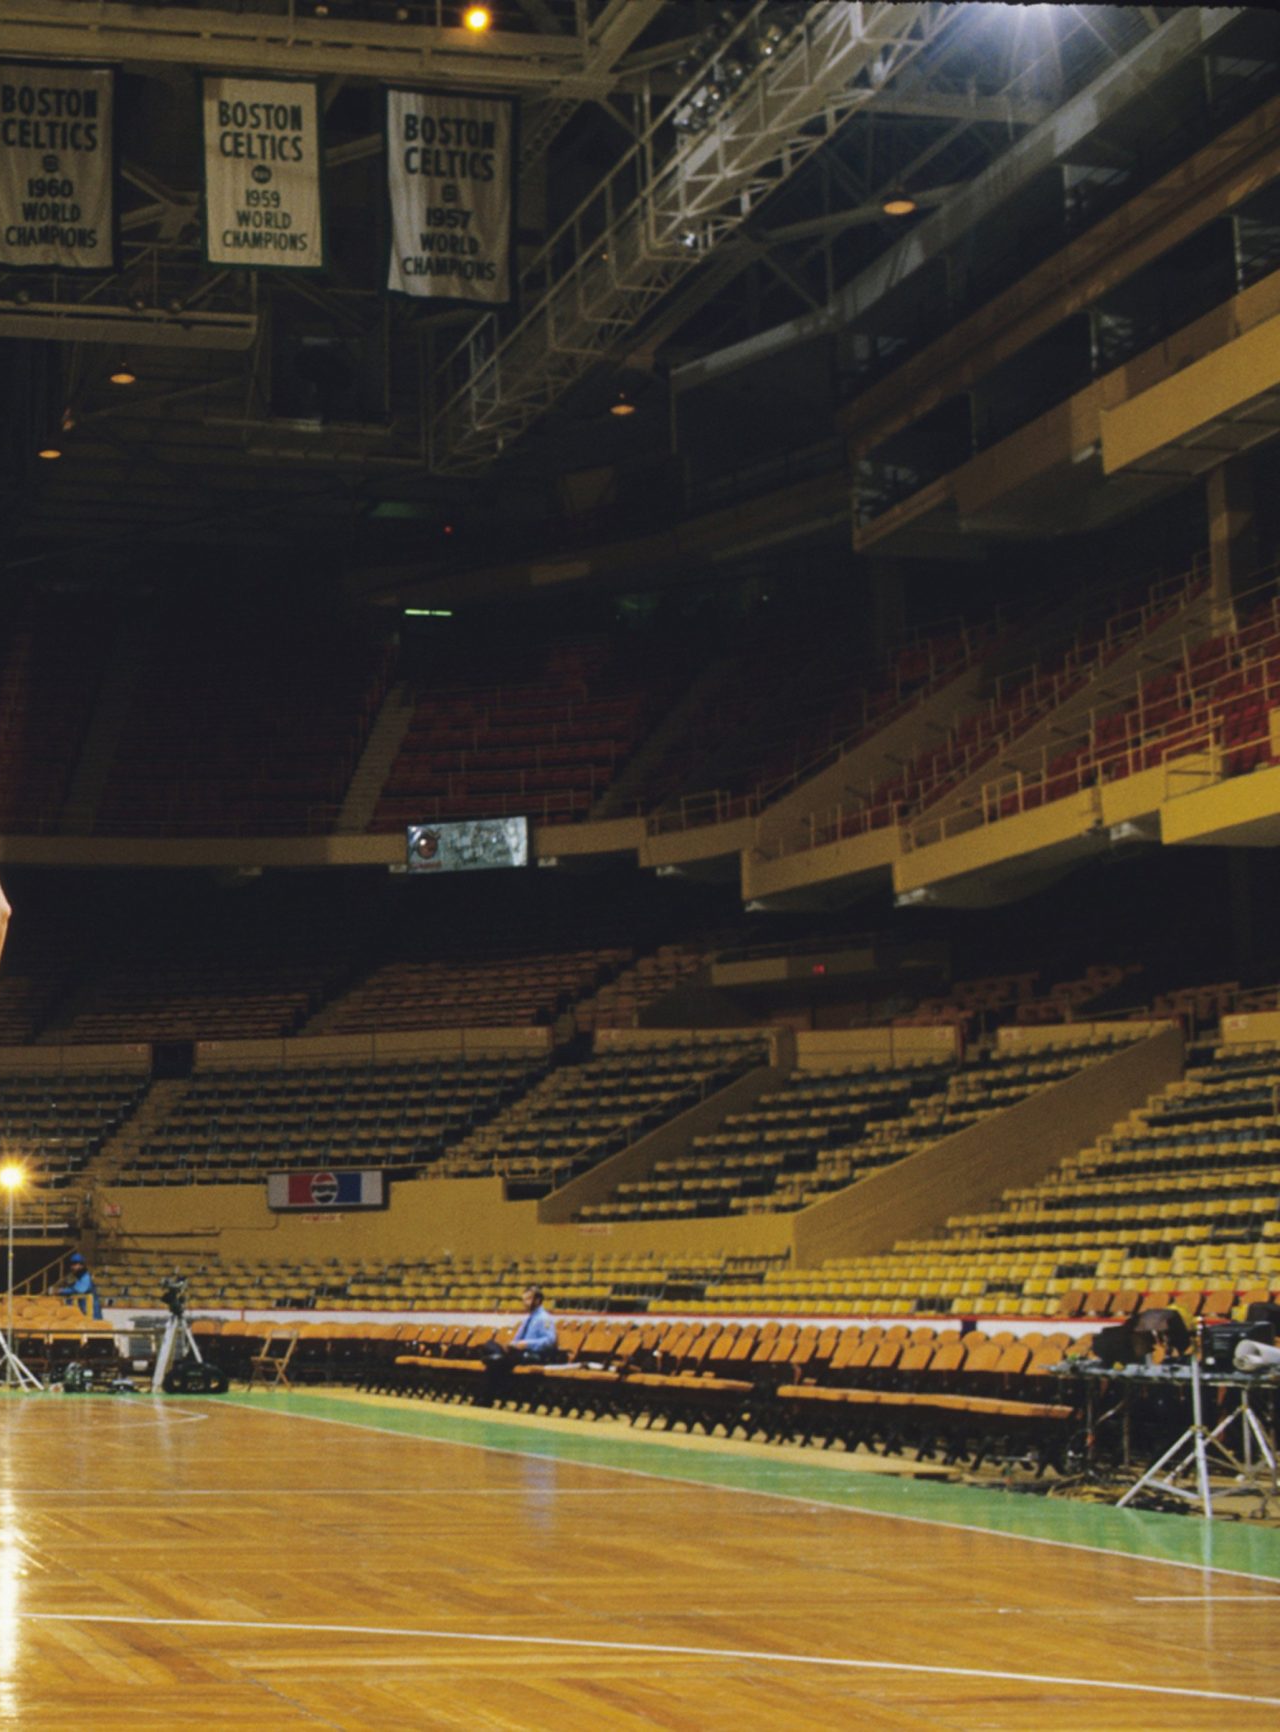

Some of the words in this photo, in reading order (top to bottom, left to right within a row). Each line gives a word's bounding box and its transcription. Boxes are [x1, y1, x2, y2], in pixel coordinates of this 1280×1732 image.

[1, 85, 98, 118] BOSTON
[218, 101, 303, 131] BOSTON
[2, 118, 98, 152] CELTICS
[404, 114, 495, 148] BOSTON
[220, 131, 303, 162] CELTICS
[404, 146, 495, 182] CELTICS
[27, 178, 74, 198] 1960
[245, 189, 280, 208] 1959
[22, 202, 81, 222] WORLD
[236, 210, 292, 230] WORLD
[426, 208, 473, 228] 1957
[5, 226, 98, 248] CHAMPIONS
[222, 230, 308, 251] CHAMPIONS
[420, 233, 479, 255] WORLD
[402, 257, 496, 280] CHAMPIONS
